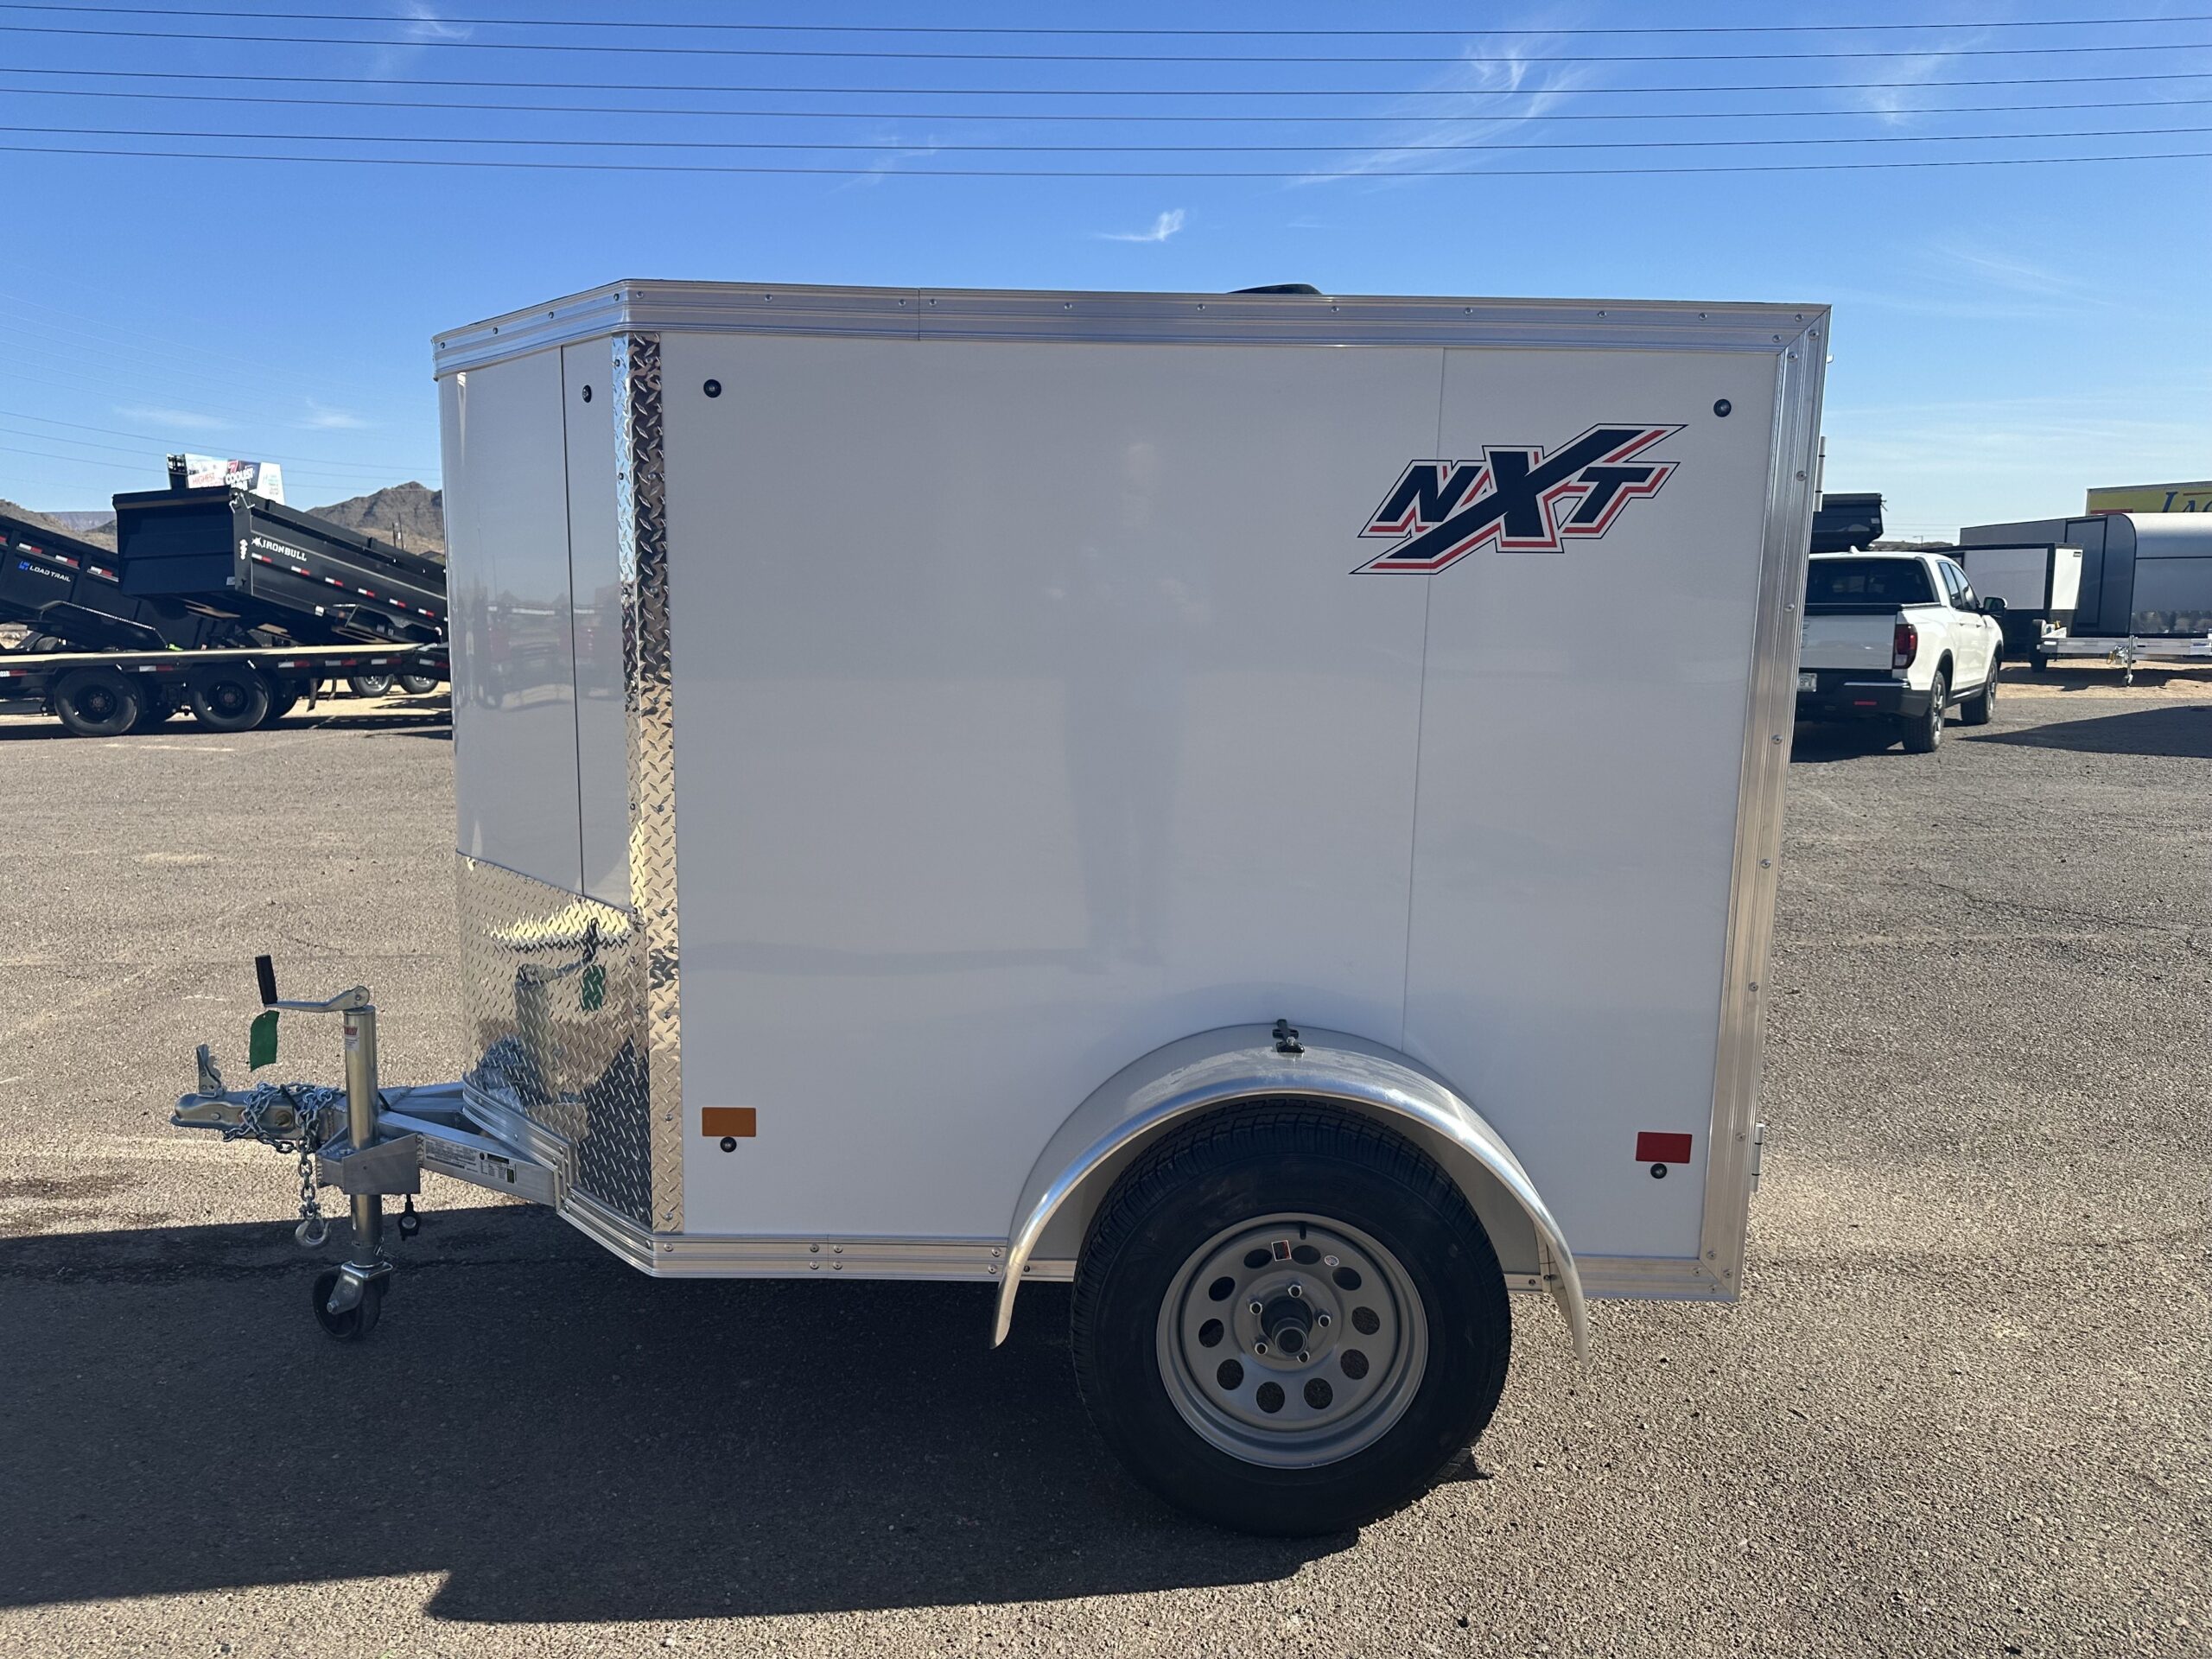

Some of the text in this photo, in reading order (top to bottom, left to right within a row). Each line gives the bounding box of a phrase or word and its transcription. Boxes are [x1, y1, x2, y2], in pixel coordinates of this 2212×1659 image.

[1350, 423, 1688, 574] NXT
[262, 539, 307, 562] IRONBULL
[29, 565, 71, 582] LOAD TRAIL
